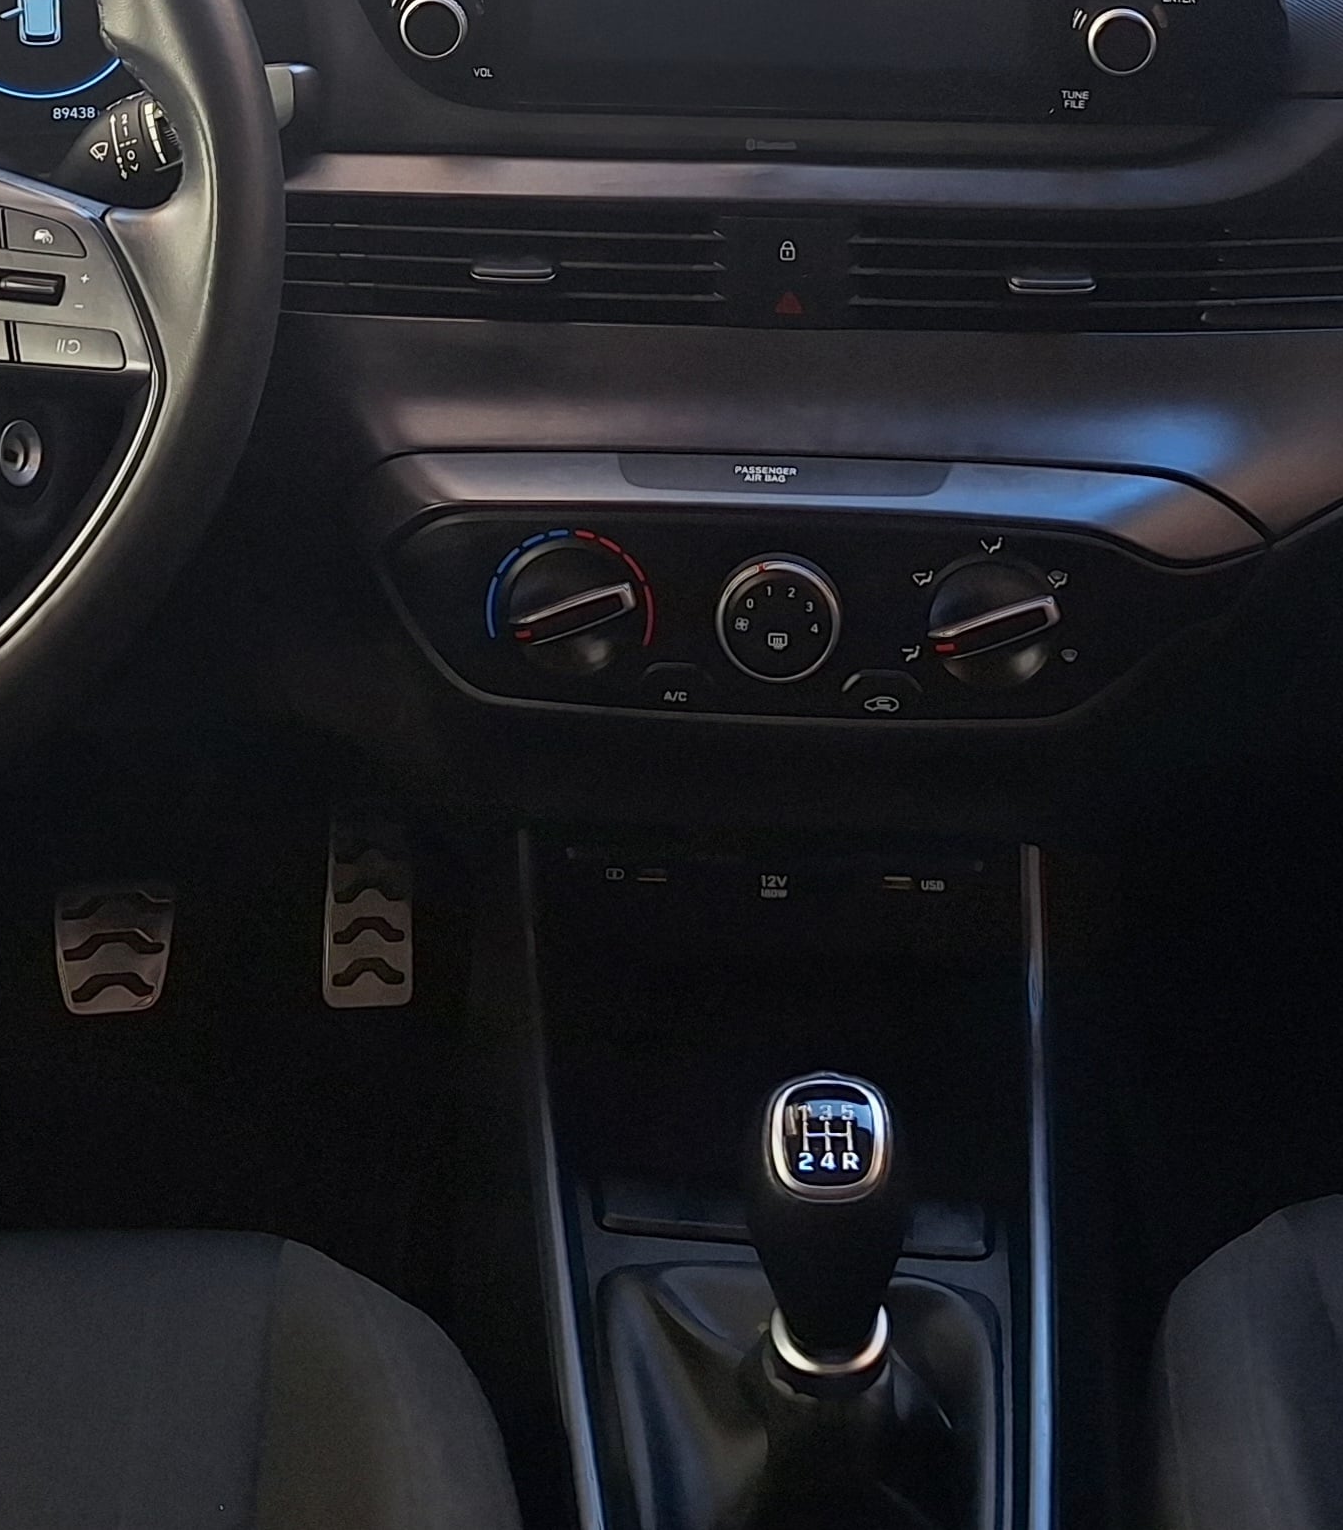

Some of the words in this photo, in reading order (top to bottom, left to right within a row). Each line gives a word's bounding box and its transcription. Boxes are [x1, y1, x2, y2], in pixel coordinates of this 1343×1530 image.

[473, 67, 493, 78] VOL
[1061, 89, 1089, 100] TUNE
[1064, 99, 1086, 110] FILE
[52, 106, 96, 120] 89438
[734, 465, 798, 477] PASSENGER
[743, 473, 762, 483] AIR
[764, 474, 787, 484] BAG
[765, 586, 773, 597] 1
[787, 587, 797, 599] 2
[745, 598, 755, 610] 0
[805, 601, 815, 613] 3
[810, 623, 819, 633] 4
[663, 690, 688, 702] A/C
[760, 874, 789, 888] 12V
[920, 879, 945, 892] USB
[818, 1104, 833, 1121] 3
[841, 1104, 855, 1121] 5
[798, 1152, 815, 1171] 2
[820, 1152, 837, 1170] 4
[842, 1152, 860, 1171] R
